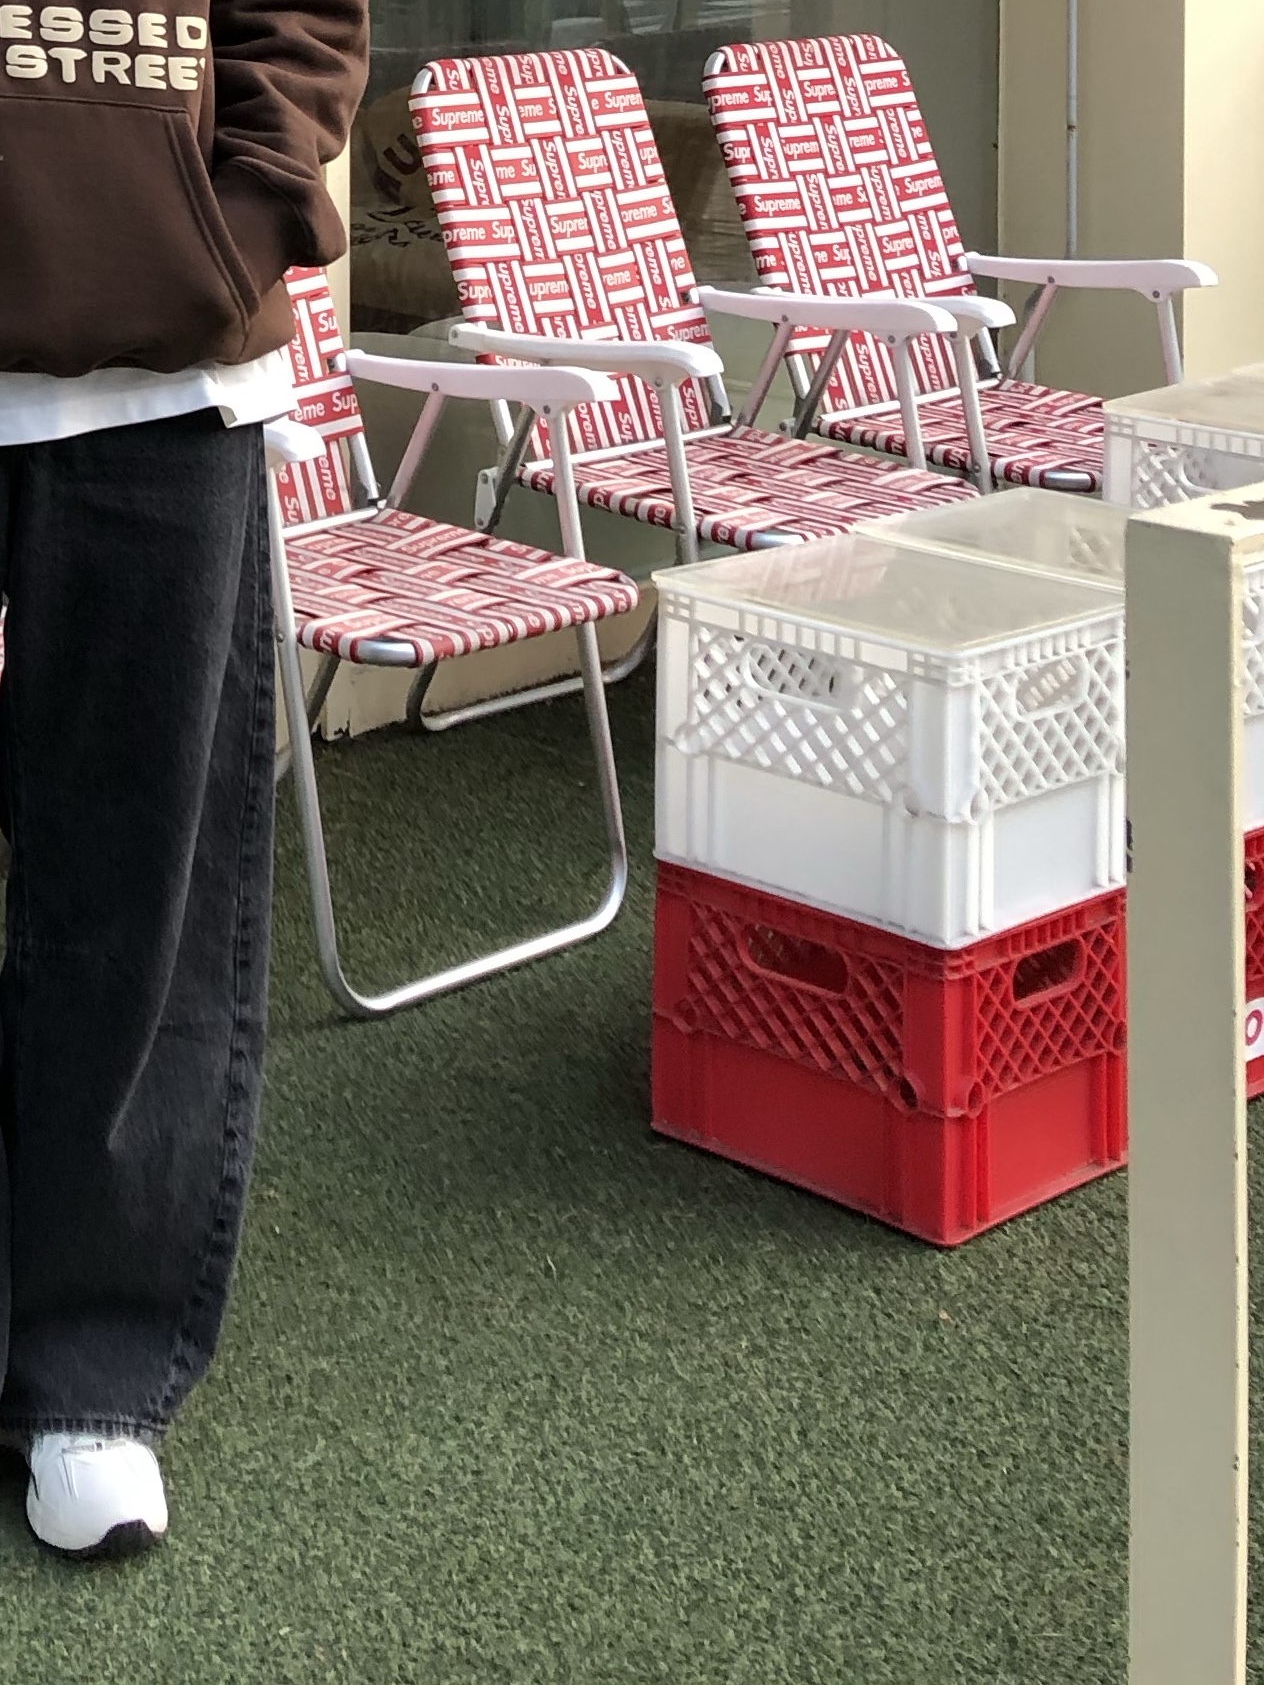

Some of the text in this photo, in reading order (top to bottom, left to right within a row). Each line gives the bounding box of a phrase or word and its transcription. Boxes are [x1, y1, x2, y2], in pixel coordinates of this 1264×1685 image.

[804, 81, 835, 101] Supre
[844, 76, 862, 116] Supr
[864, 76, 898, 96] preme
[564, 84, 584, 135] Supre
[604, 90, 643, 112] Suprem
[709, 92, 749, 113] preme
[431, 107, 485, 130] Supreme
[496, 103, 513, 144] Supr
[849, 132, 875, 148] reme
[887, 109, 907, 159] preme
[612, 130, 636, 188] uprem
[724, 143, 750, 163] Supr
[761, 136, 779, 179] Supr
[785, 140, 819, 159] uprem
[825, 123, 846, 173] Supre
[578, 152, 607, 173] Supr
[470, 159, 489, 205] Supr
[904, 176, 943, 197] Suprem
[621, 203, 657, 223] preme
[754, 195, 801, 216] Supreme
[550, 215, 587, 237] Supre
[591, 190, 617, 250] preme
[442, 226, 486, 246] preme
[882, 236, 913, 256] Supre
[644, 241, 662, 285] reme
[852, 224, 877, 282] preme
[574, 253, 597, 310] preme
[603, 269, 632, 286] reme
[457, 282, 493, 304] Supr
[499, 262, 525, 333] upreme
[529, 280, 569, 301] uprem
